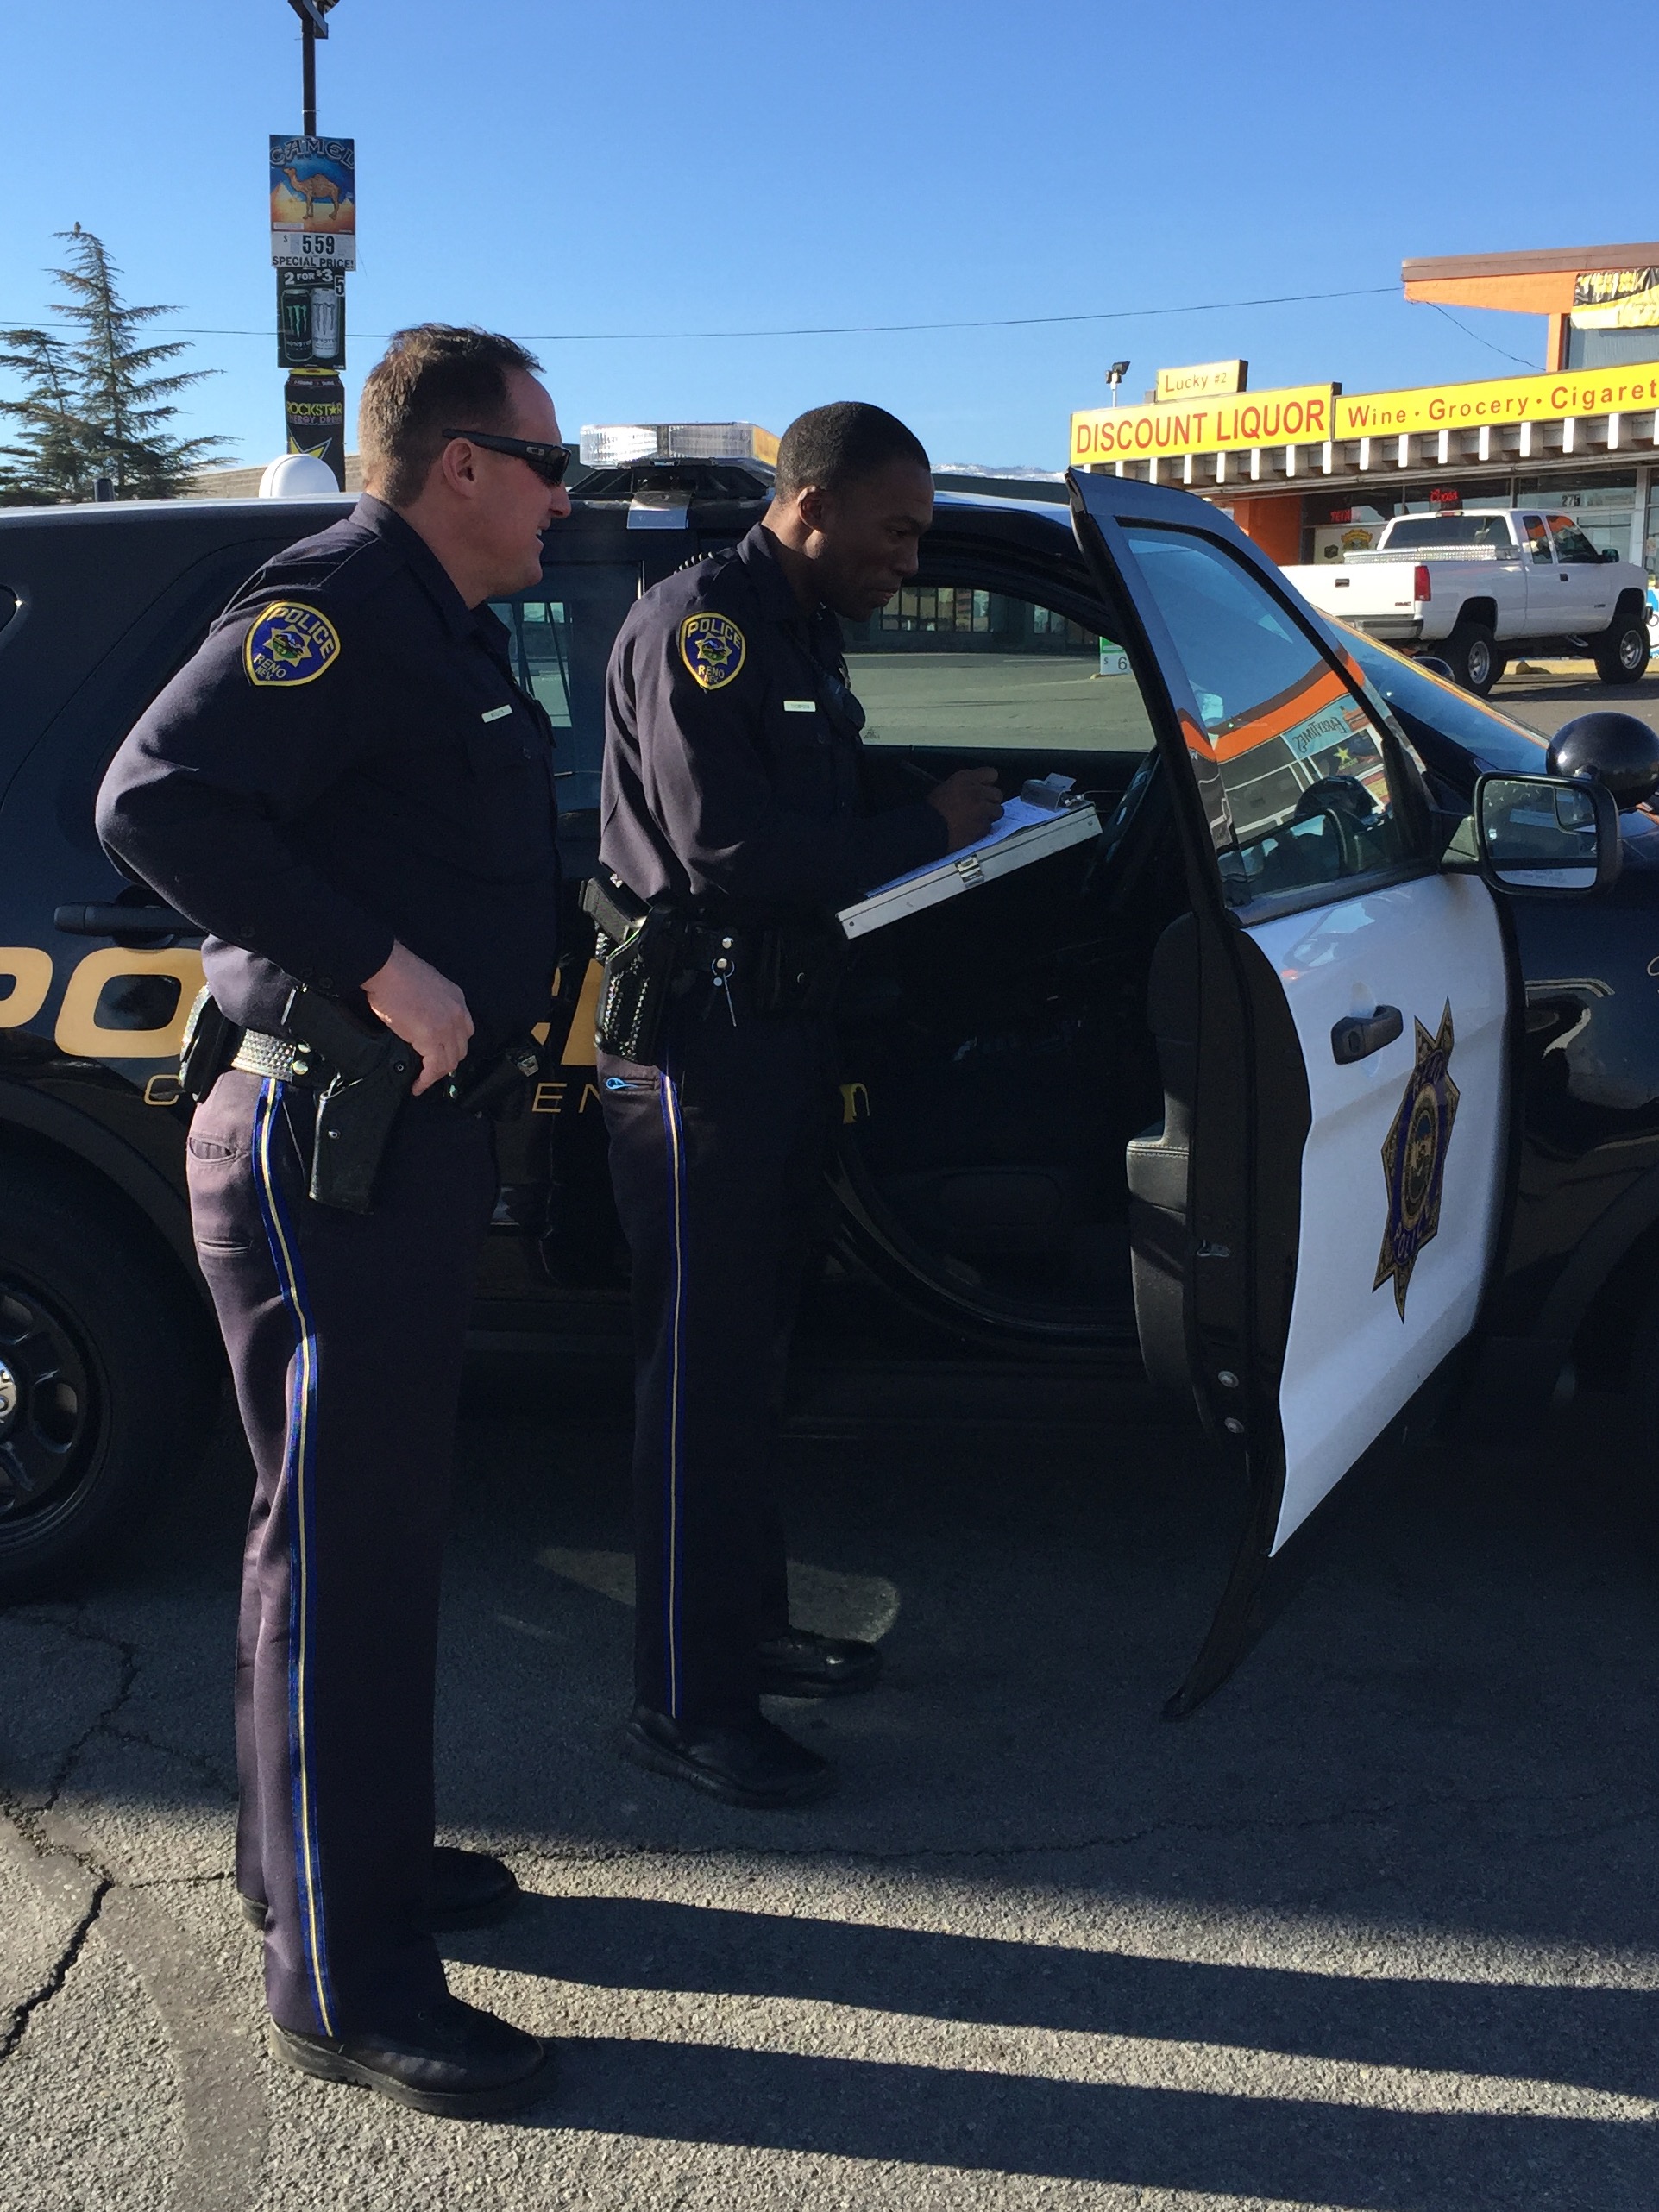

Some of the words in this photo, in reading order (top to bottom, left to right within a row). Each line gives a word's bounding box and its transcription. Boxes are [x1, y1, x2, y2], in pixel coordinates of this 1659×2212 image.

[270, 137, 354, 169] CAMEL
[273, 256, 317, 267] SPECIAL
[319, 258, 354, 269] PRICE!
[284, 272, 295, 286] 2
[1165, 374, 1208, 393] Lucky
[1214, 372, 1227, 384] #2
[1076, 412, 1208, 454] DISCOUNT
[1216, 399, 1325, 442] LIQUOR
[1348, 405, 1407, 429] Wine
[1428, 398, 1530, 422] Grocery
[267, 607, 335, 660] POLICE
[687, 619, 742, 650] POLICE
[253, 653, 286, 678] RENO
[698, 664, 725, 679] RENO
